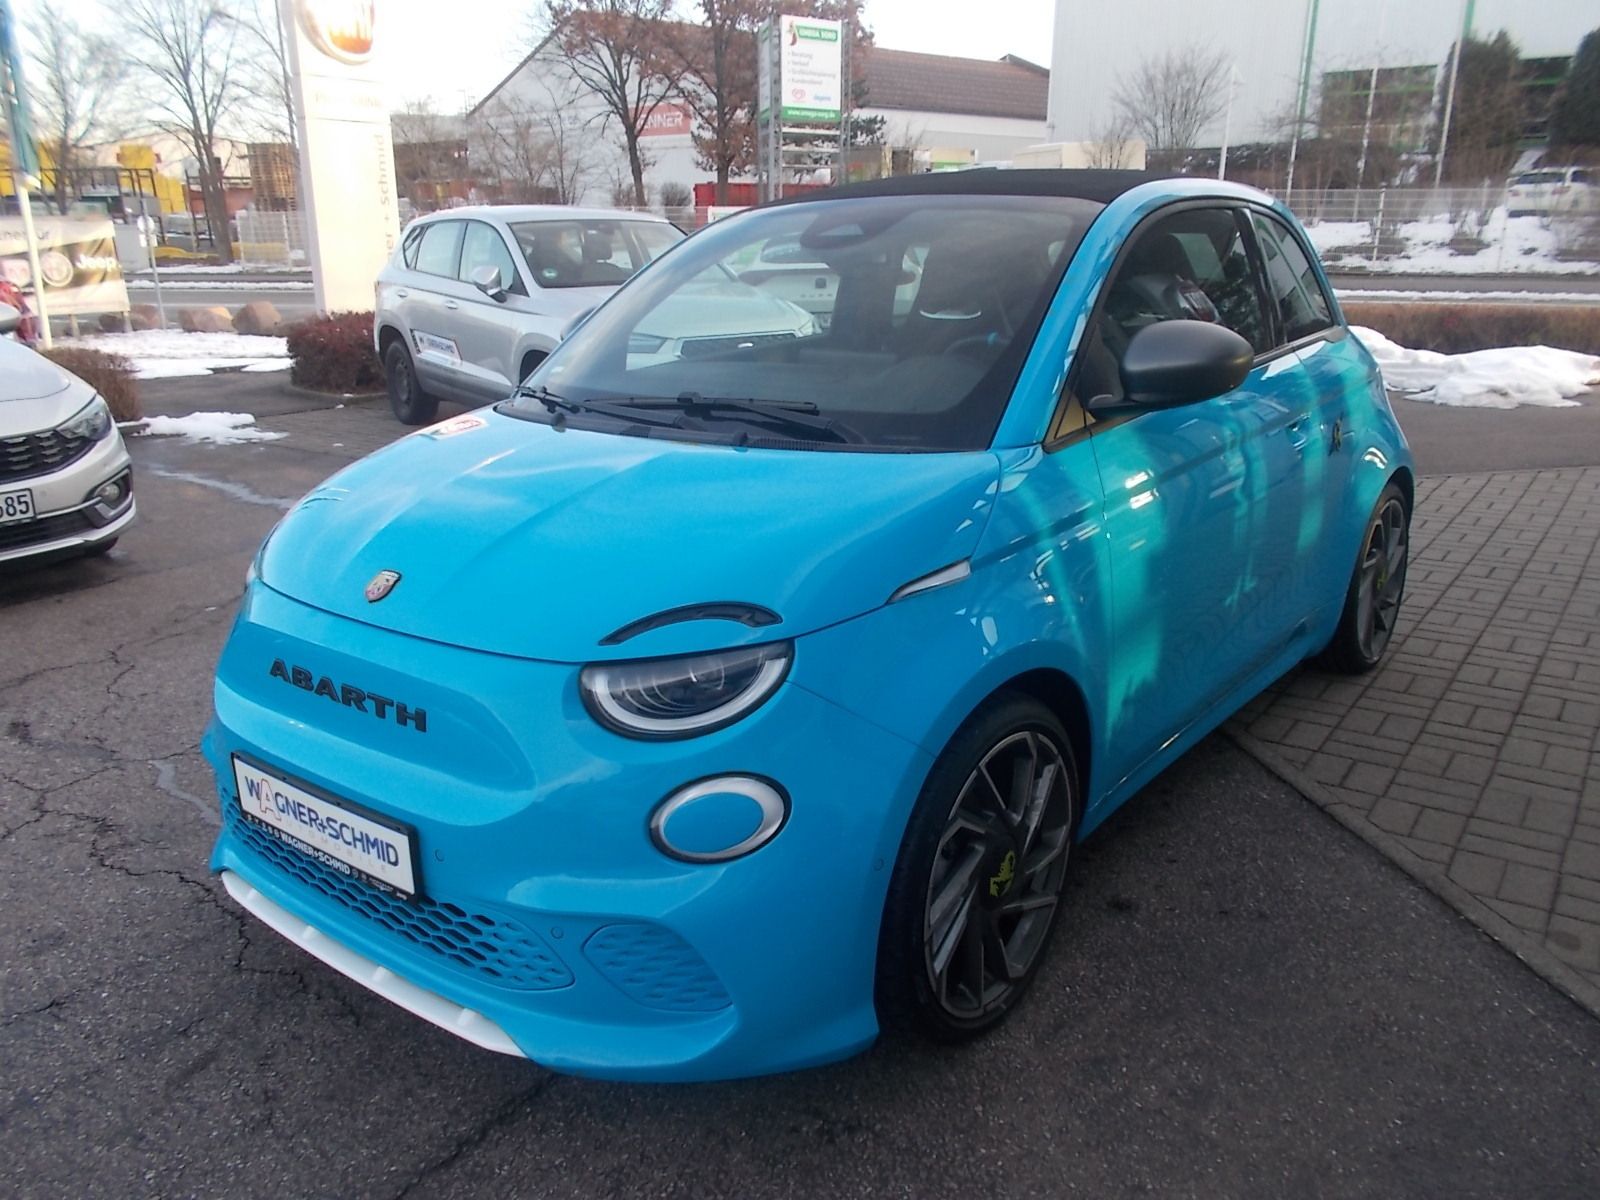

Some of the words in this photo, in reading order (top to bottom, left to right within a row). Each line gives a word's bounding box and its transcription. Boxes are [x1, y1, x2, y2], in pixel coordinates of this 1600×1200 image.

[76, 253, 117, 272] Jeep
[269, 657, 427, 733] ABARTH
[244, 776, 400, 868] WAGNER+SCHMID
[280, 830, 350, 875] WAGNER+SCHMID
